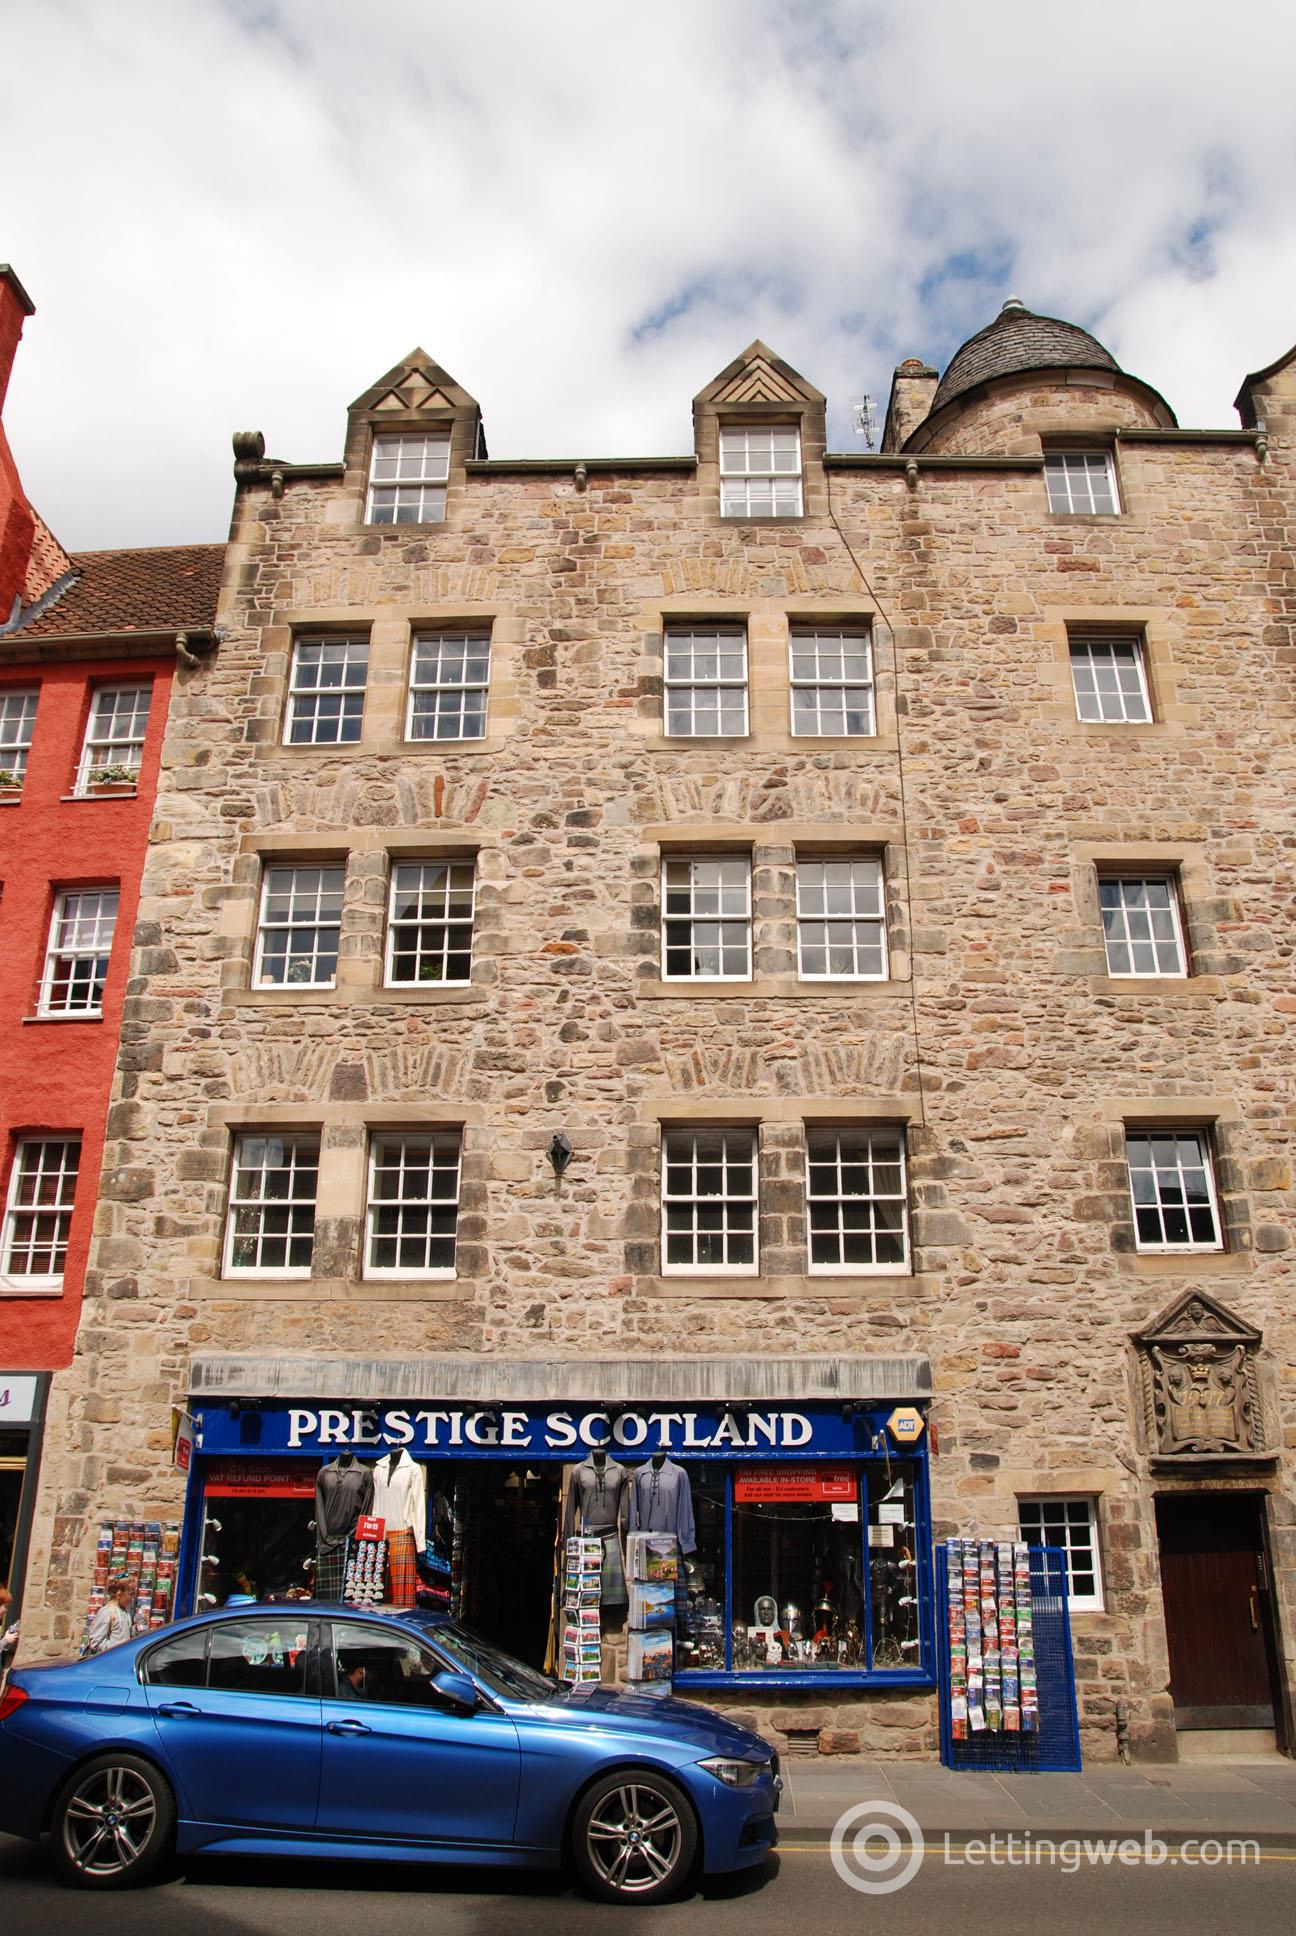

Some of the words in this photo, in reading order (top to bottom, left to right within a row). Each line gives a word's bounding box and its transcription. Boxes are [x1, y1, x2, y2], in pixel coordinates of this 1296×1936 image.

[287, 1409, 532, 1447] PRESTIGE
[544, 1411, 813, 1447] SCOTLAND
[898, 1420, 915, 1430] ADT
